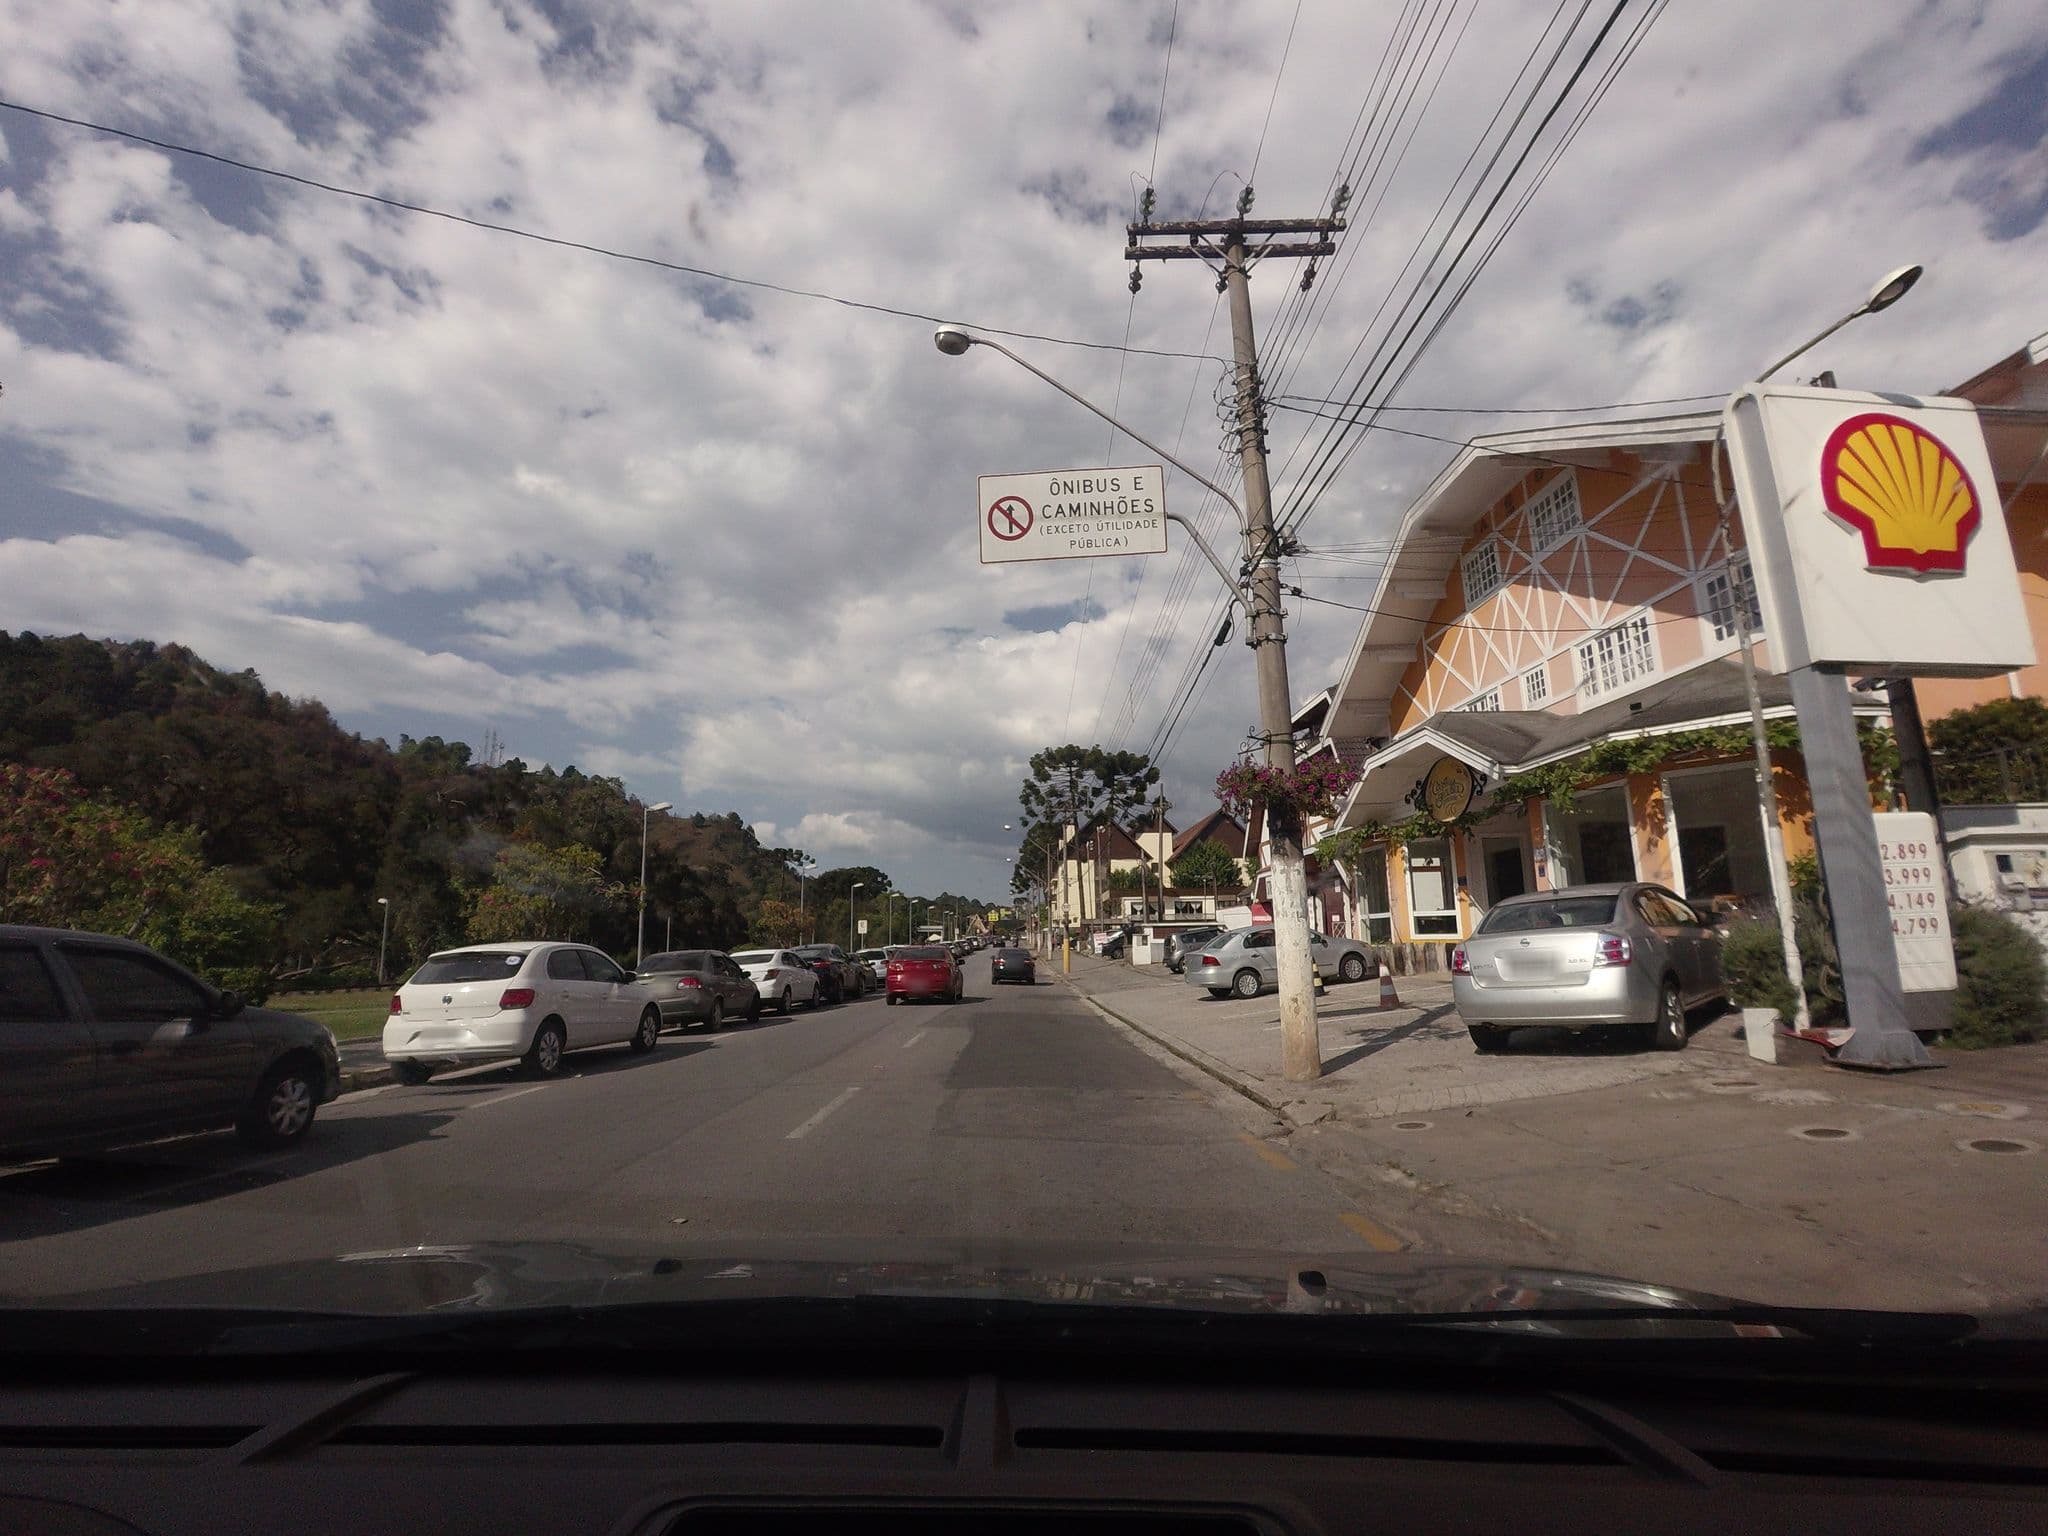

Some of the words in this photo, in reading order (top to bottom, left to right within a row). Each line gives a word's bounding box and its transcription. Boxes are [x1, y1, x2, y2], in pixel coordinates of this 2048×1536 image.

[1050, 477, 1121, 496] ÔNIBUS
[1133, 476, 1144, 491] E
[1042, 496, 1154, 519] CAMINHÕES
[1039, 523, 1090, 536] (EXCETO
[1069, 536, 1129, 549] PÚBLICA)
[1880, 843, 1928, 860] 2.899
[1884, 866, 1931, 885] 3.999
[1887, 892, 1935, 910] 4.149
